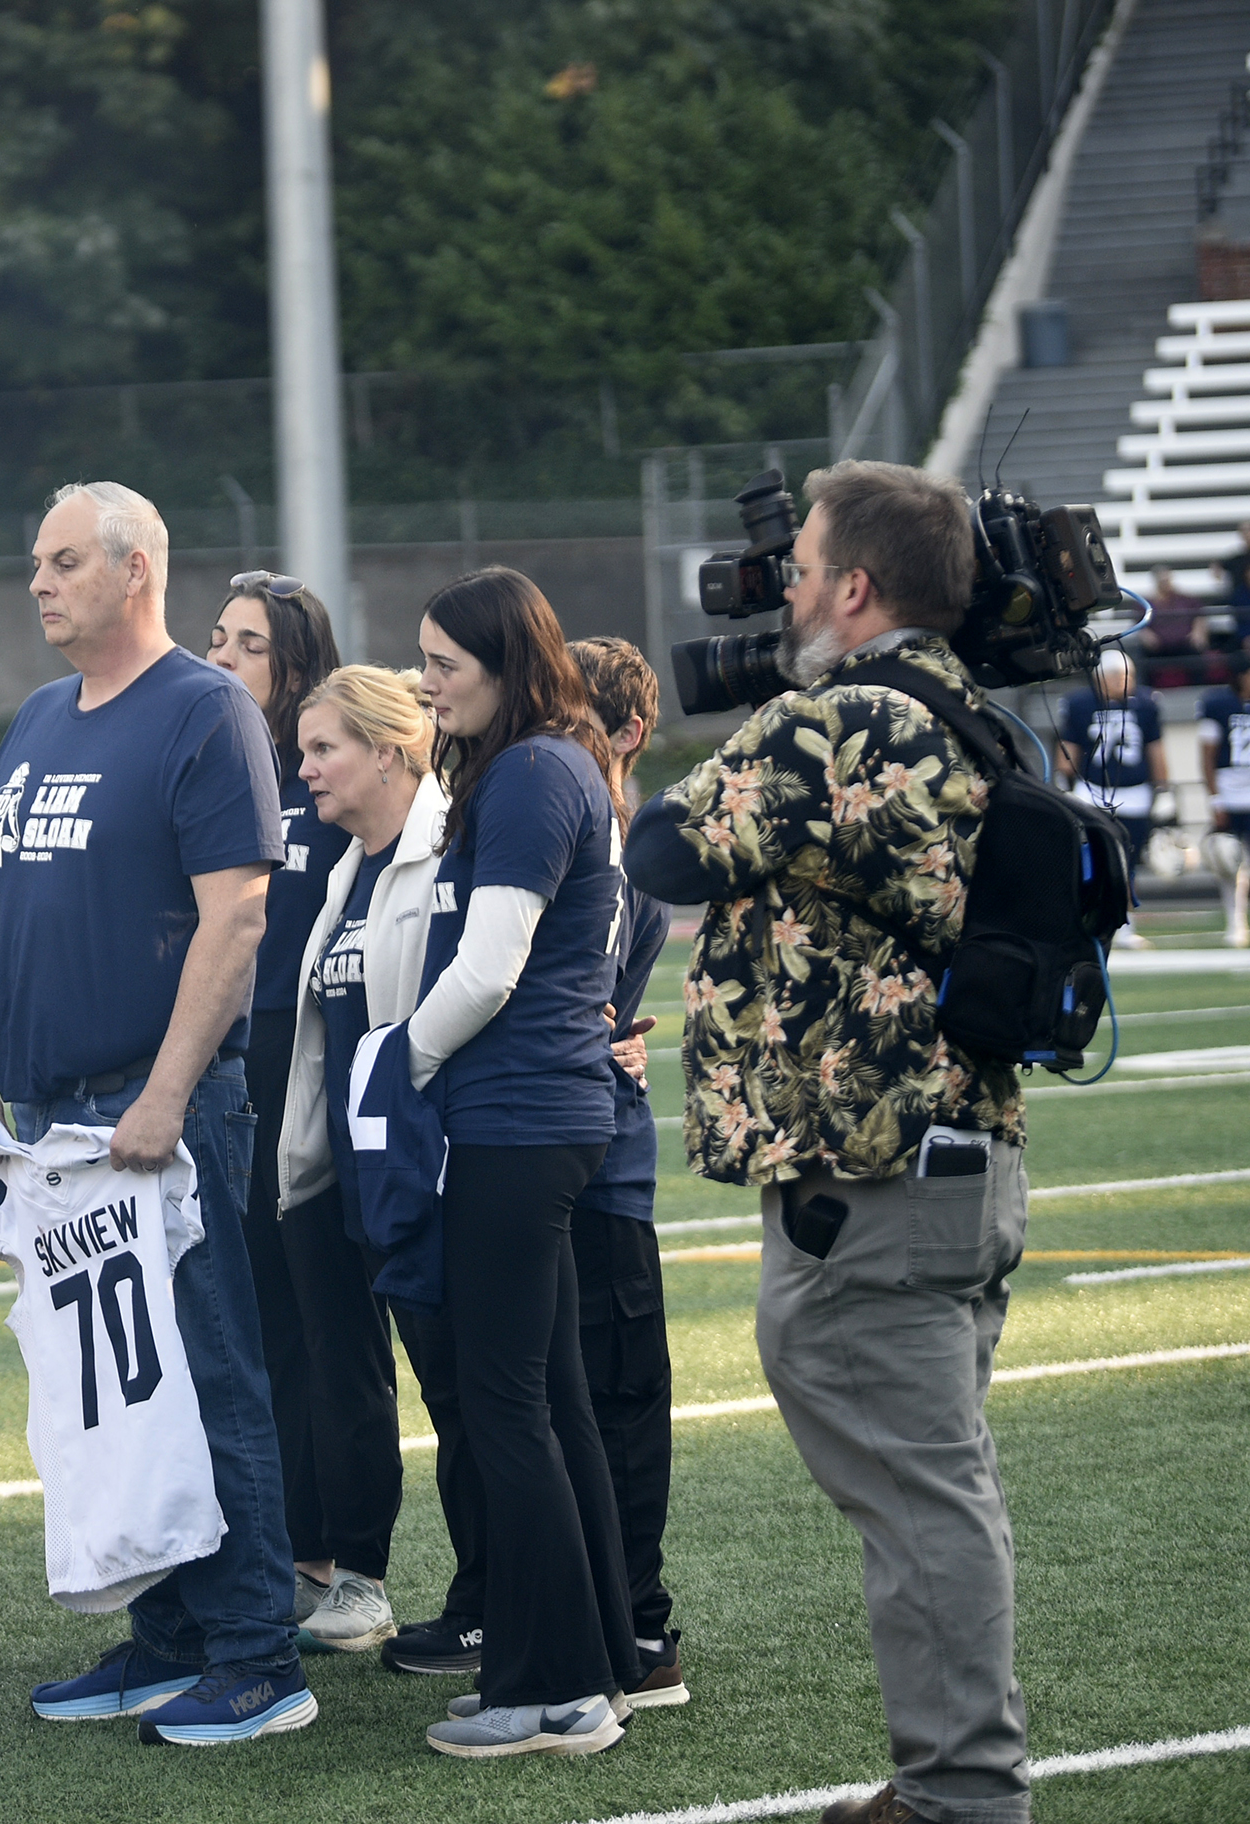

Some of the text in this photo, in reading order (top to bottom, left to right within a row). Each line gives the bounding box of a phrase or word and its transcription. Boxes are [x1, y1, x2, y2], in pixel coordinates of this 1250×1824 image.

[31, 786, 87, 814] LIAM
[22, 818, 93, 850] SLOAN
[323, 953, 366, 986] SLOA
[45, 1171, 62, 1186] S
[34, 1195, 139, 1278] SKYVIEW
[49, 1250, 163, 1431] 70
[459, 1628, 482, 1648] HO
[228, 1680, 276, 1717] HOKA
